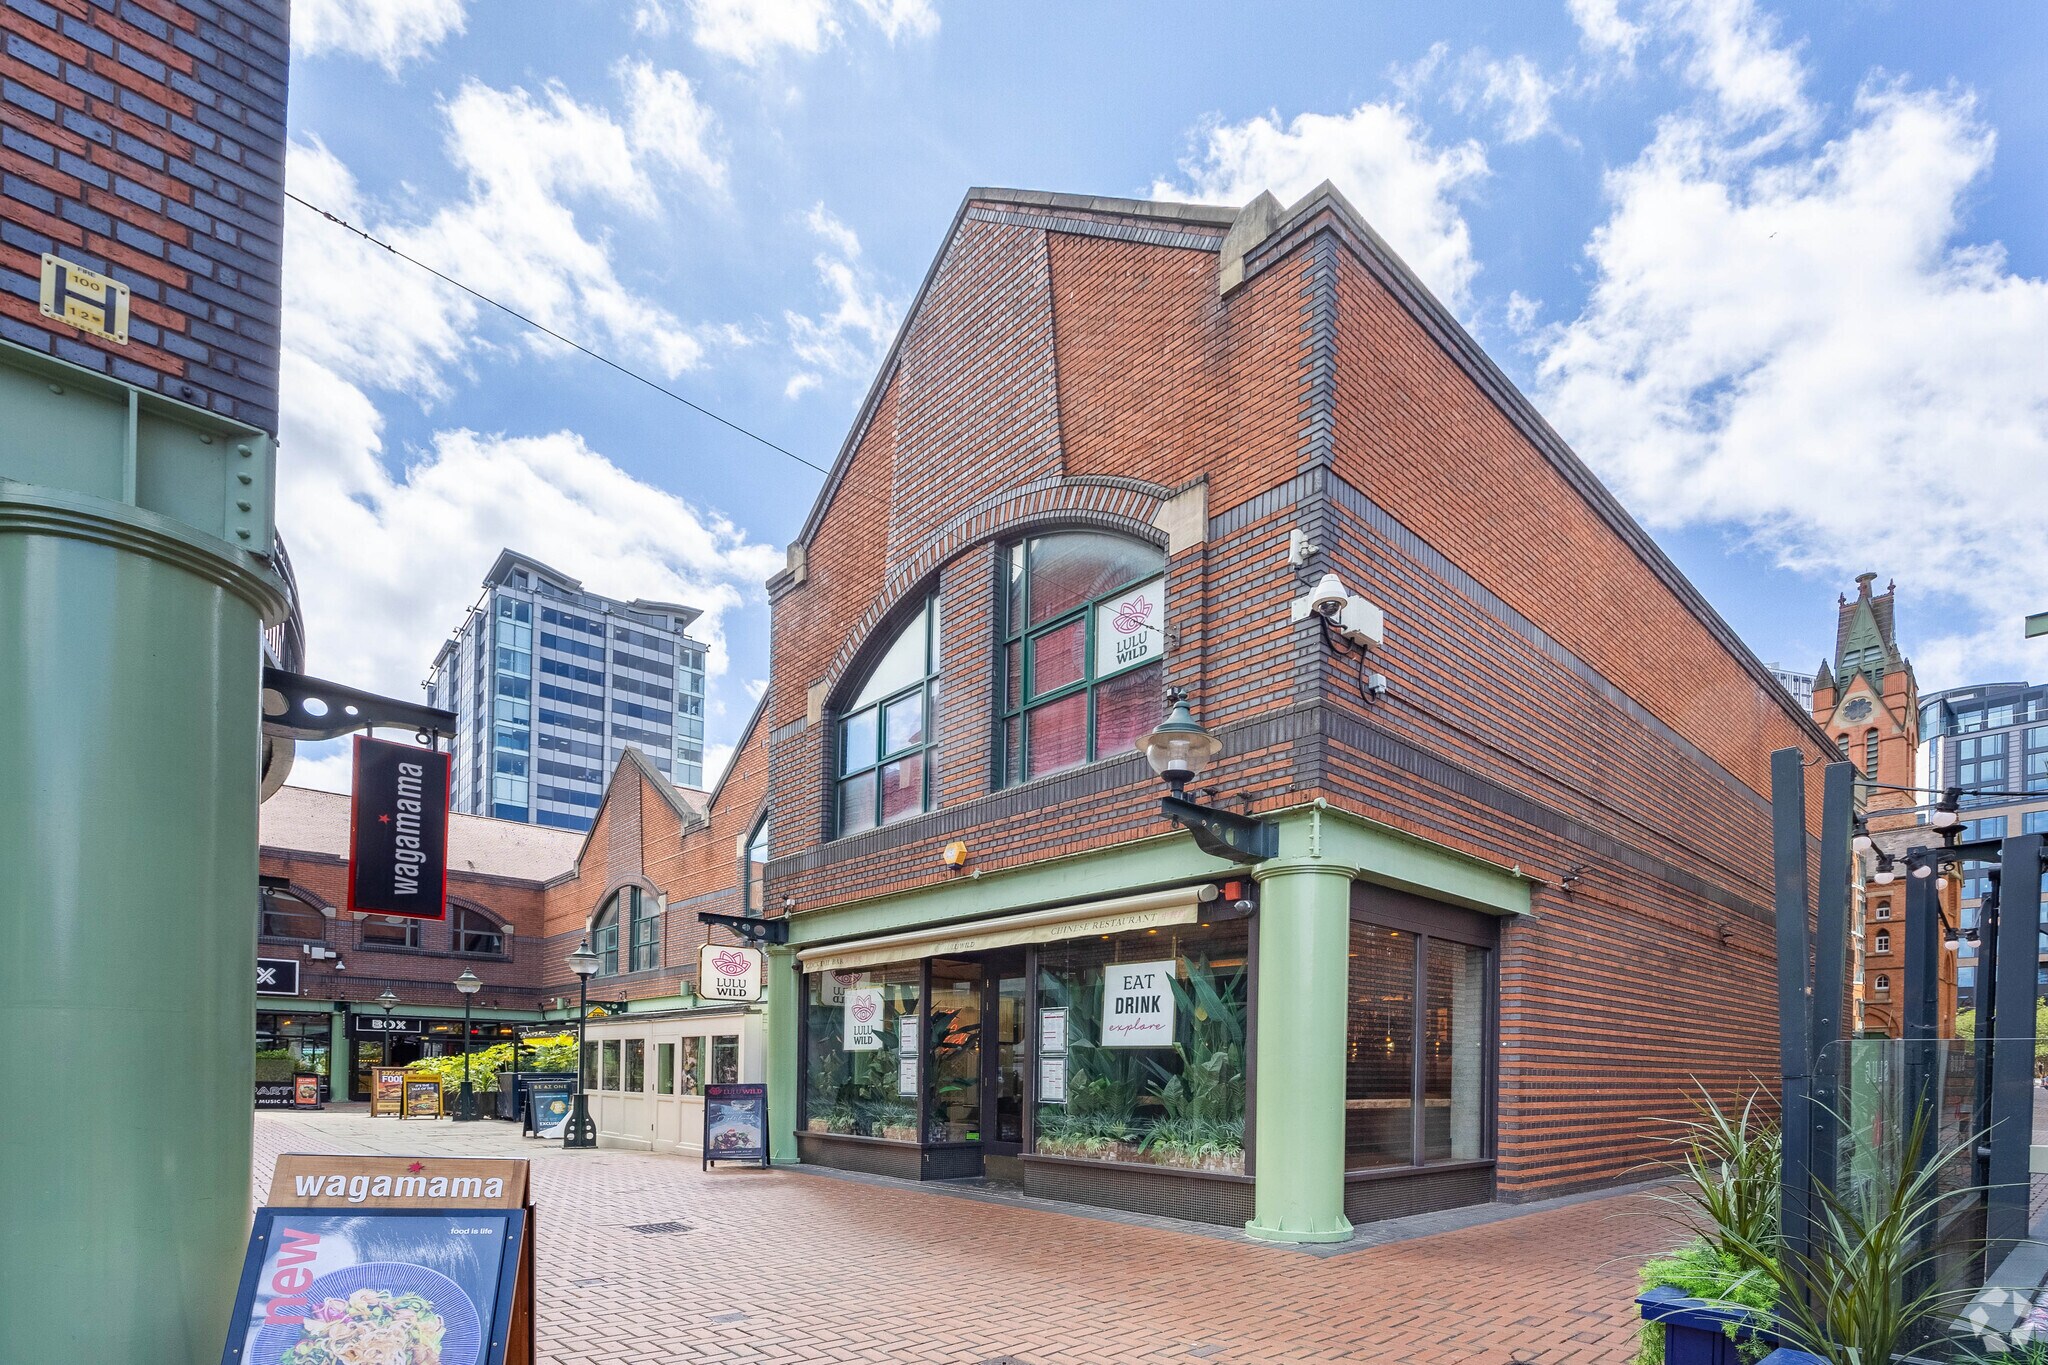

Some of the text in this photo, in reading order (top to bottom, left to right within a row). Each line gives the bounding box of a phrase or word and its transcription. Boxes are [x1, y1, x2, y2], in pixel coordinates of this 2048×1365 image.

[73, 275, 100, 291] 100
[54, 264, 117, 336] H
[1117, 631, 1147, 653] LULU
[1116, 645, 1147, 664] WILD
[394, 762, 427, 895] wagamama
[1051, 924, 1089, 936] CHINESE
[1092, 913, 1158, 929] RESTAURANT
[717, 977, 747, 989] LULU
[1123, 973, 1156, 990] EAT
[716, 988, 747, 997] WILD
[1115, 995, 1161, 1014] DRINK
[372, 1019, 406, 1030] BOX
[854, 1025, 873, 1035] LULU
[1108, 1017, 1166, 1037] explore
[854, 1036, 873, 1045] WILD
[295, 1174, 504, 1203] wagamama
[480, 1227, 493, 1235] life
[264, 1227, 321, 1325] new
